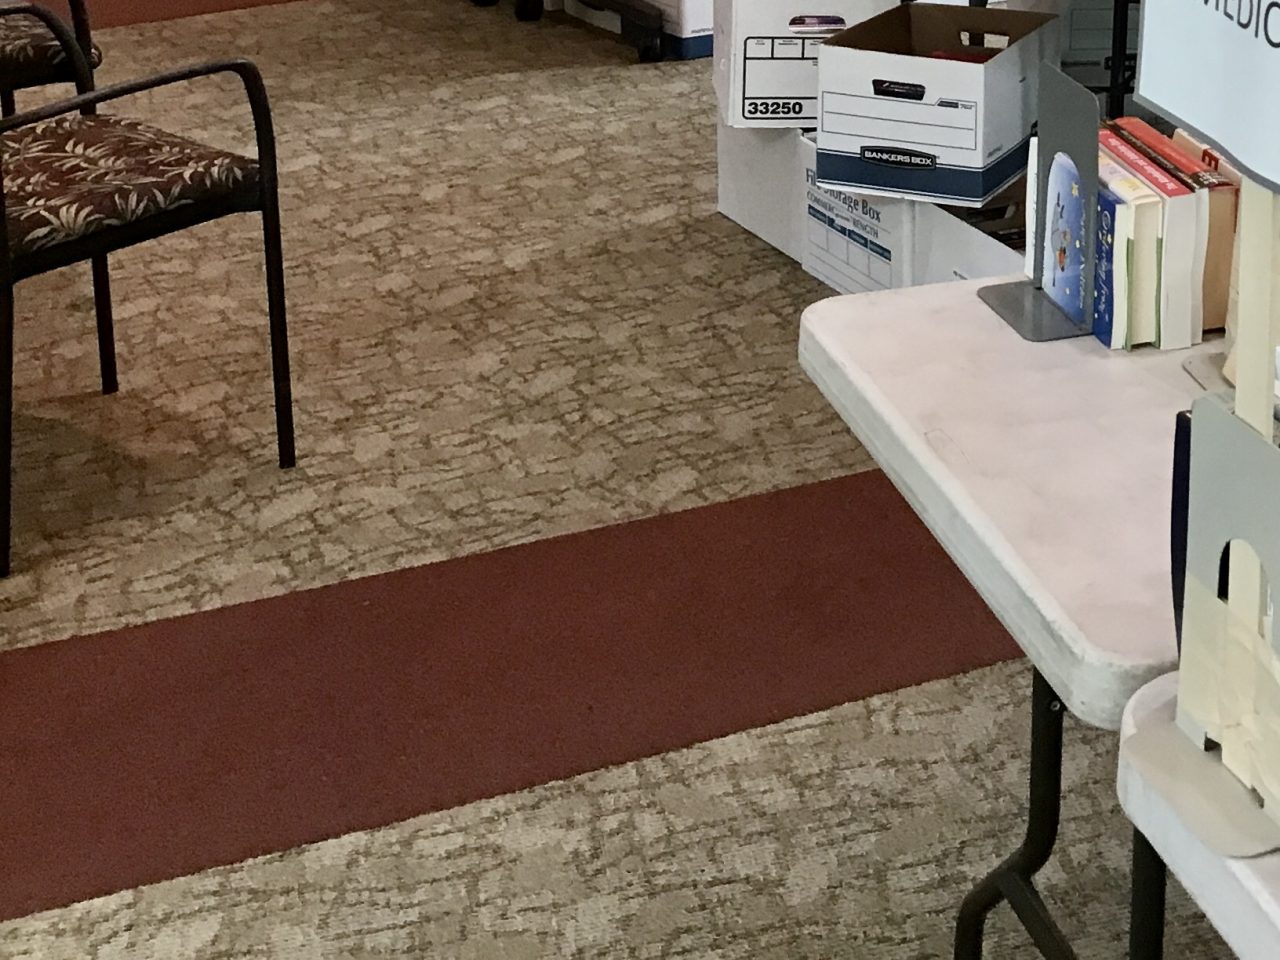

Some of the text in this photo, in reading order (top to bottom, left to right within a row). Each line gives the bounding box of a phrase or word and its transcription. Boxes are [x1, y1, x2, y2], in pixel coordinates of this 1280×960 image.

[747, 100, 803, 116] 33250
[864, 149, 933, 167] BANKERS BOX
[806, 167, 821, 190] Fil
[861, 198, 882, 224] Box
